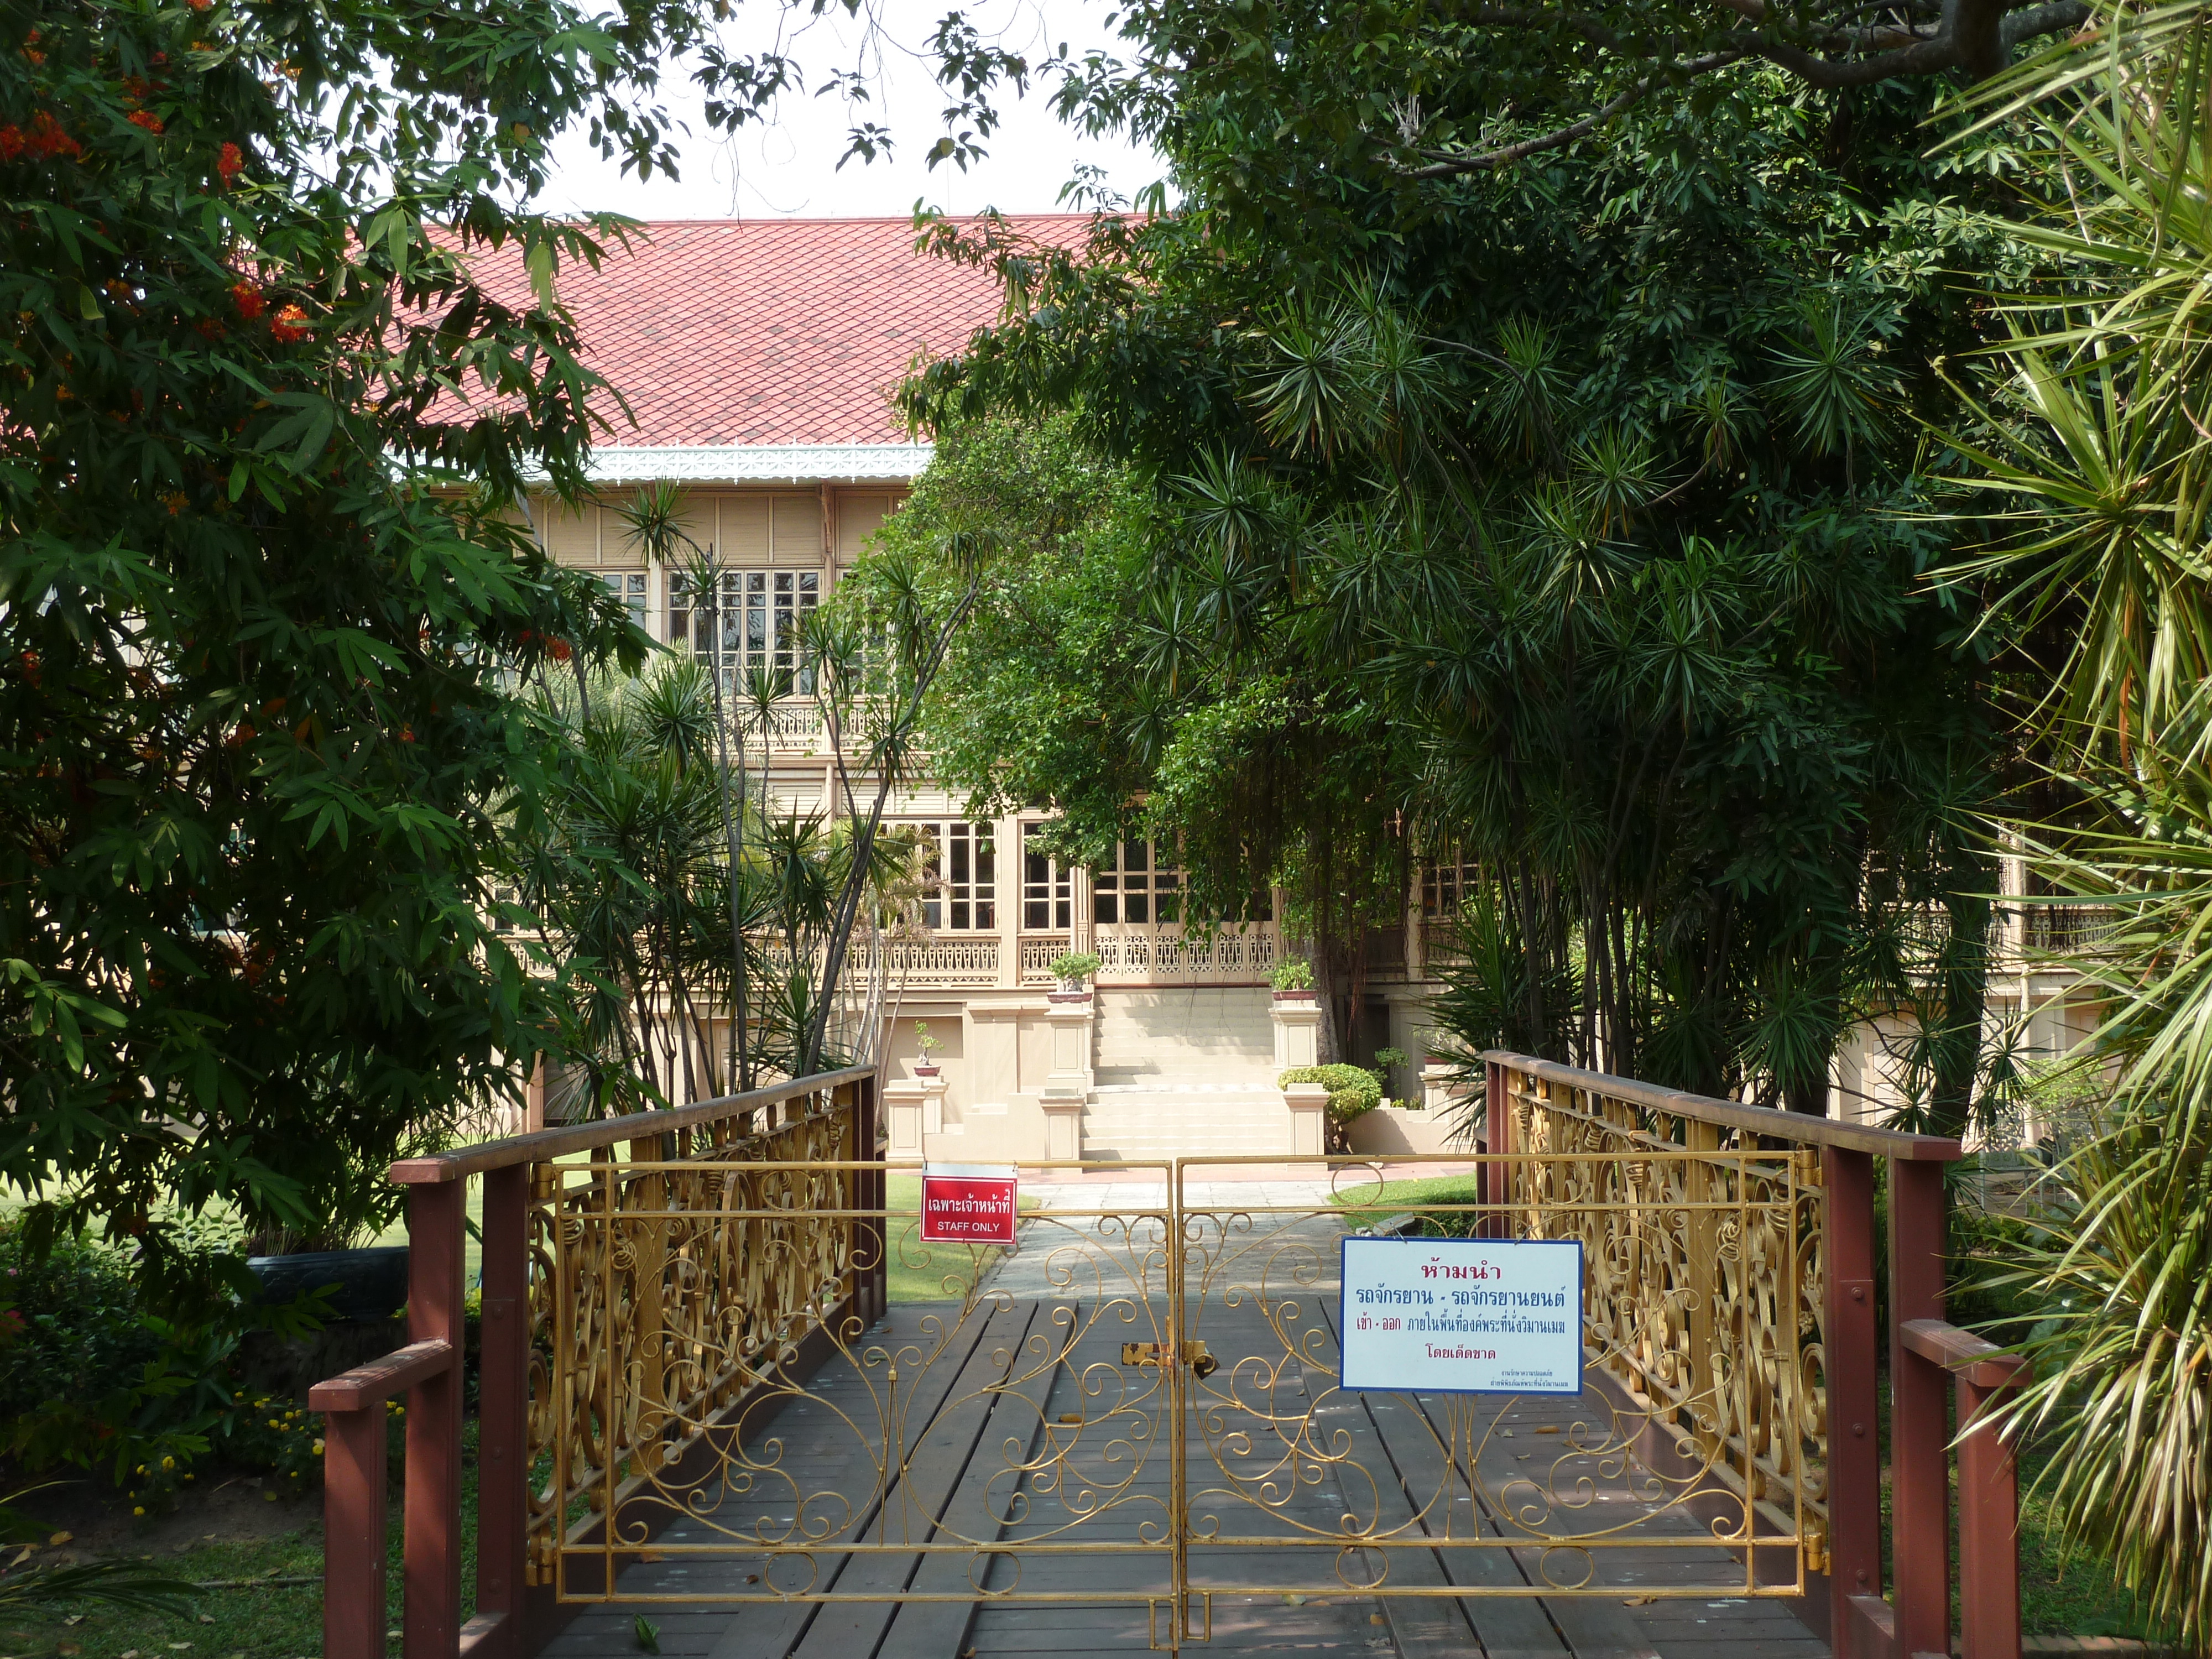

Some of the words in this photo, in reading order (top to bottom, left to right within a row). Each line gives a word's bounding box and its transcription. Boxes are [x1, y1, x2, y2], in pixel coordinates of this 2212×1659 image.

[928, 1188, 1011, 1214] เฉพาะเจ้าหน้าที่
[937, 1221, 969, 1231] STAFF
[972, 1223, 1000, 1232] ONLY
[1421, 1256, 1501, 1280] ห้ามนำ
[1356, 1283, 1434, 1305] รถจักรยาน
[1451, 1285, 1566, 1307] รถจักรยานยนต์
[1357, 1312, 1372, 1330] เข้า
[1383, 1317, 1401, 1331] ออก
[1425, 1343, 1496, 1359] โดยเด็ดขาด
